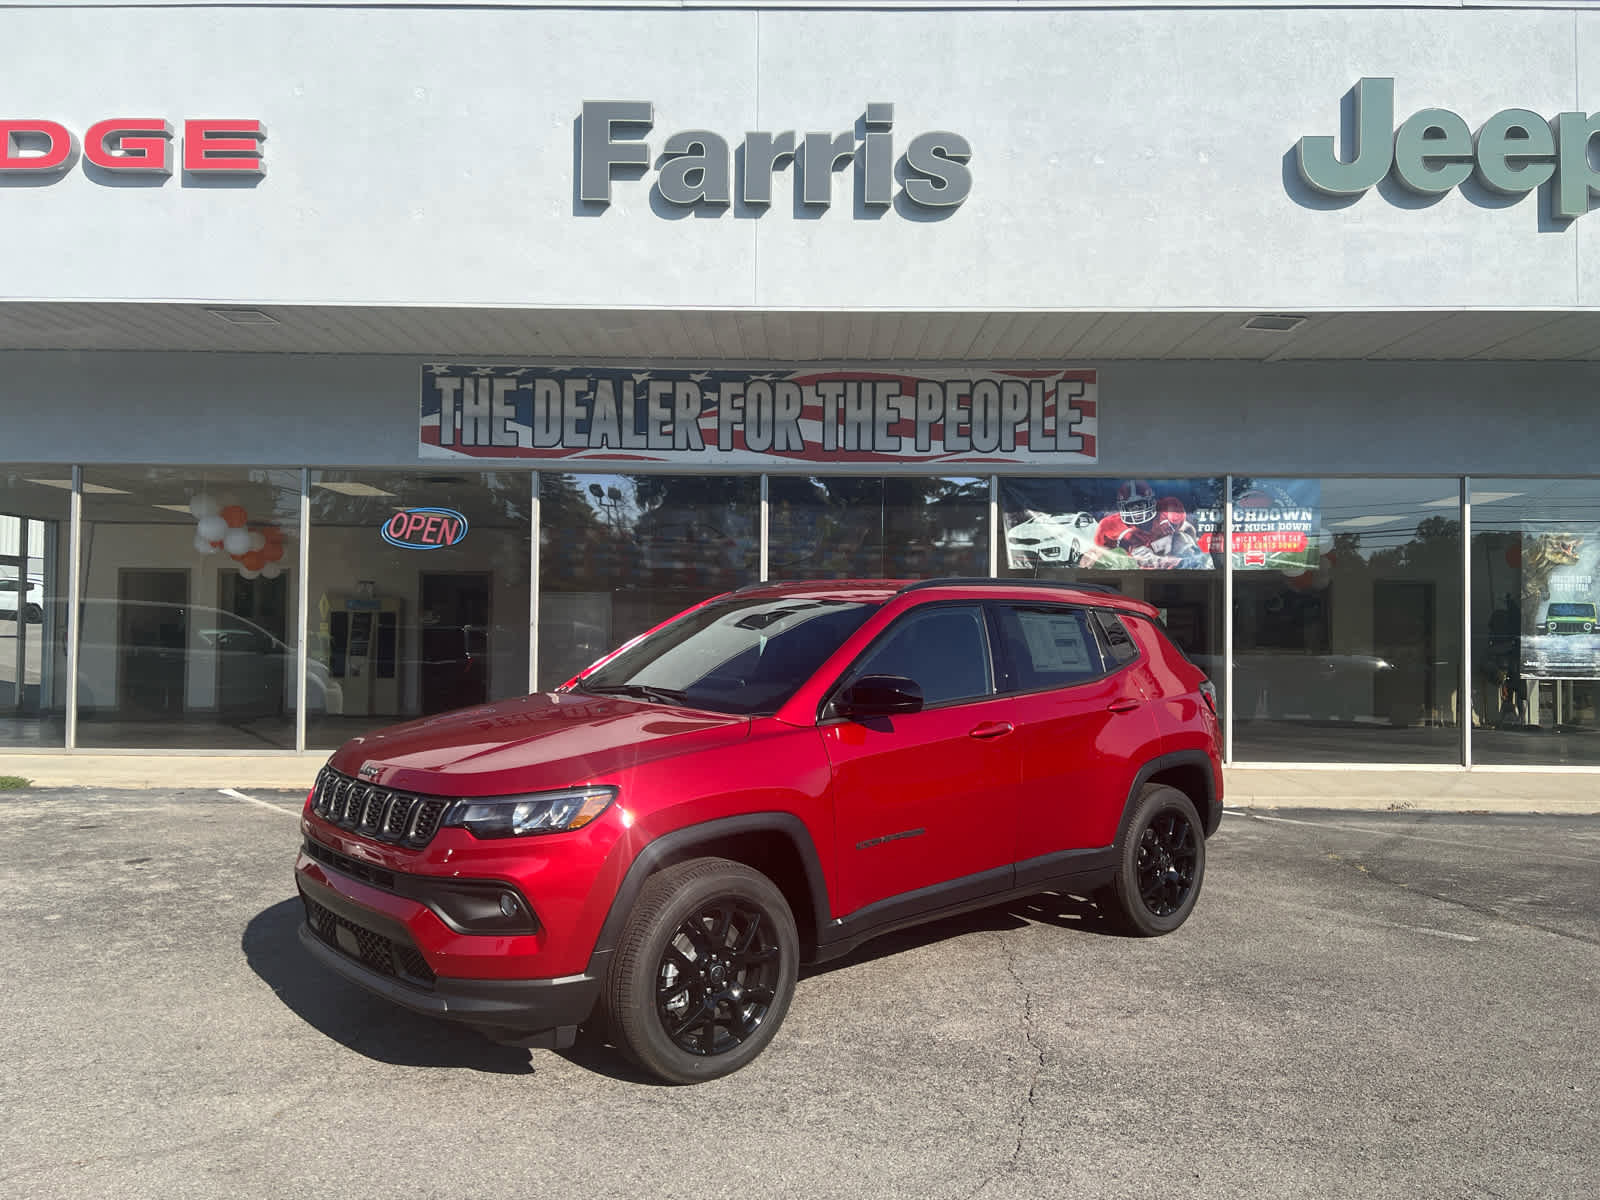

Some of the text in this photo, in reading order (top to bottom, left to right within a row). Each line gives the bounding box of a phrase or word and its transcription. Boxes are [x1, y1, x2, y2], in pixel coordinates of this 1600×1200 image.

[580, 100, 973, 207] Farris
[1300, 77, 1600, 217] Jeep
[434, 376, 1085, 453] THE DEALER FOR THE PEOPLE
[389, 512, 459, 545] OPEN
[1196, 508, 1313, 521] TOCHDOWN
[1198, 523, 1216, 532] FOR
[1245, 523, 1274, 532] MUCH
[1279, 522, 1312, 532] DOWN!
